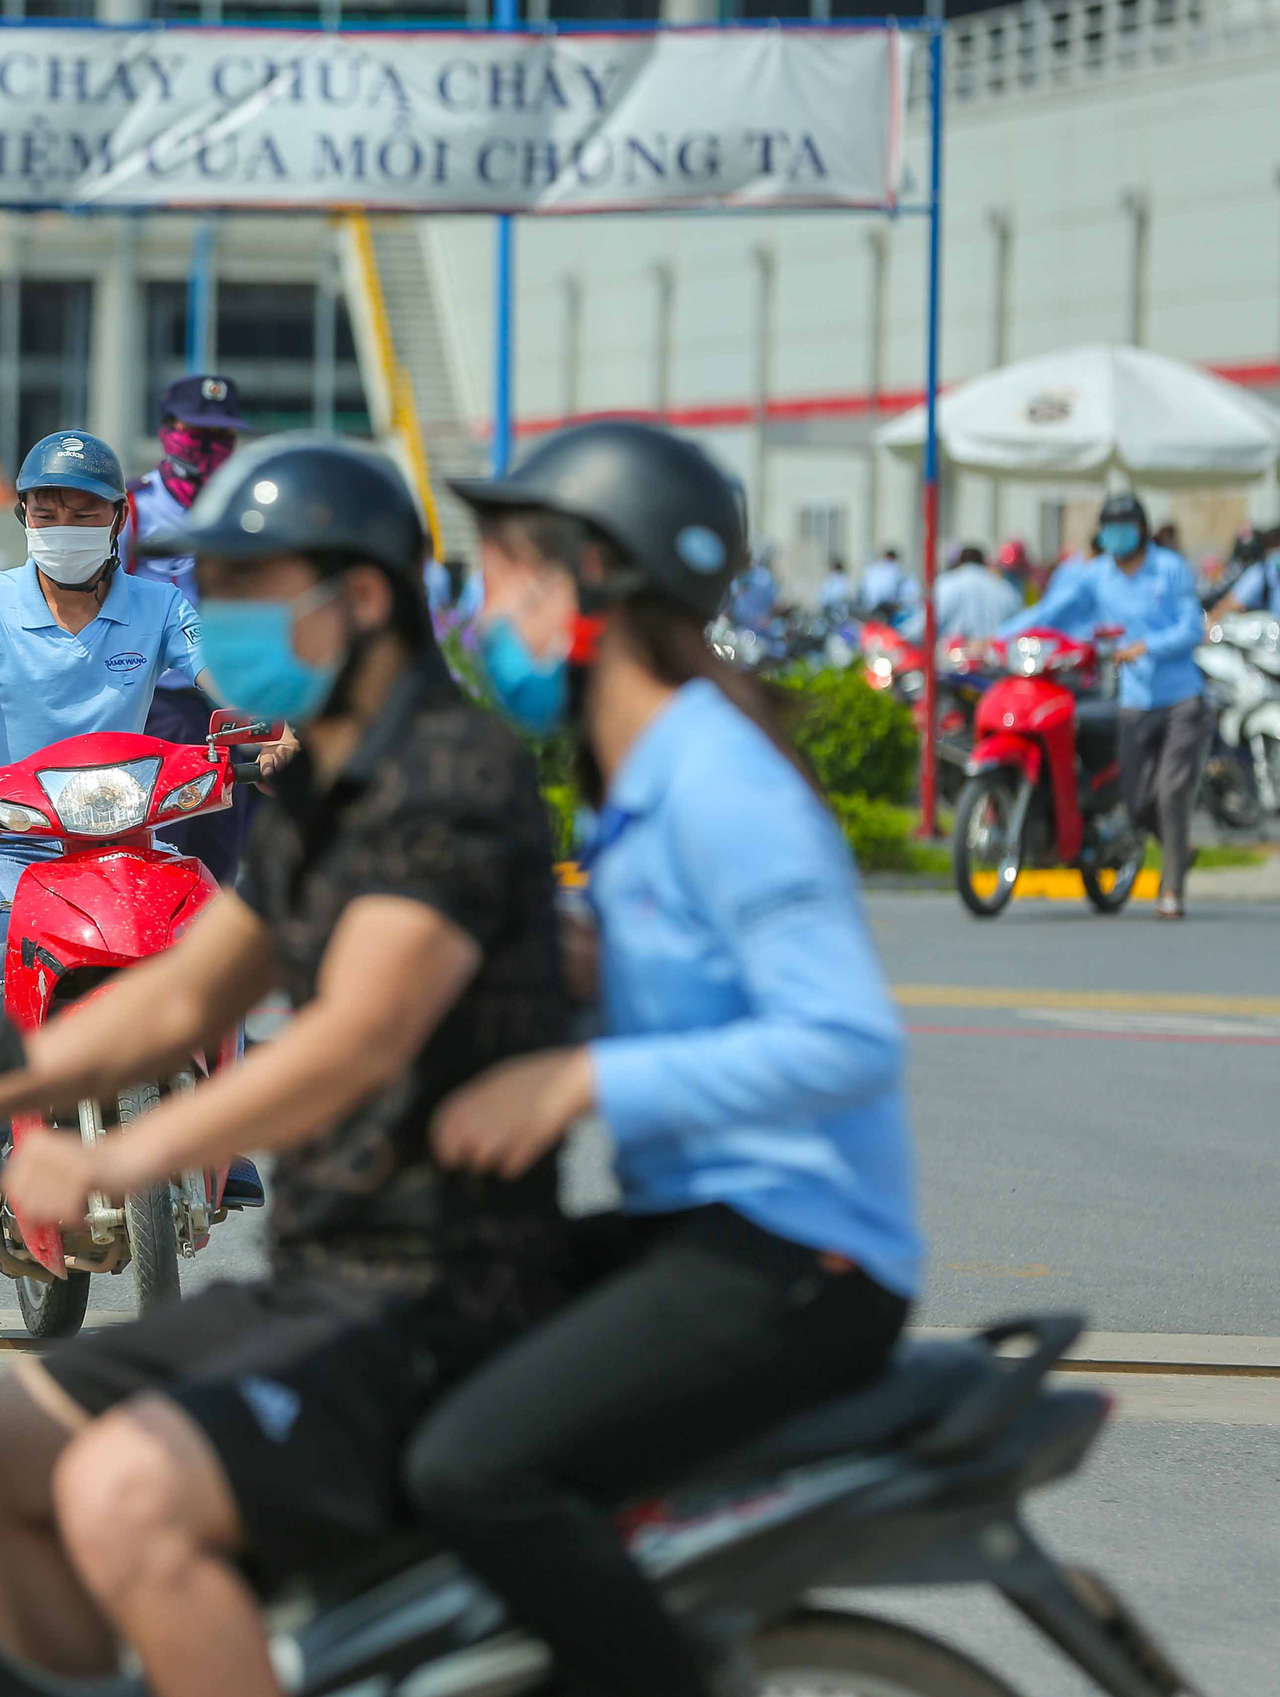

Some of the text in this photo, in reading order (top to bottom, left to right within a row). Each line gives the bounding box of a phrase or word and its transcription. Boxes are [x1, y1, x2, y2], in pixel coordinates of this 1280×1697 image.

[742, 129, 829, 182] TA
[57, 451, 85, 460] adidas
[97, 852, 147, 864] HONDA
